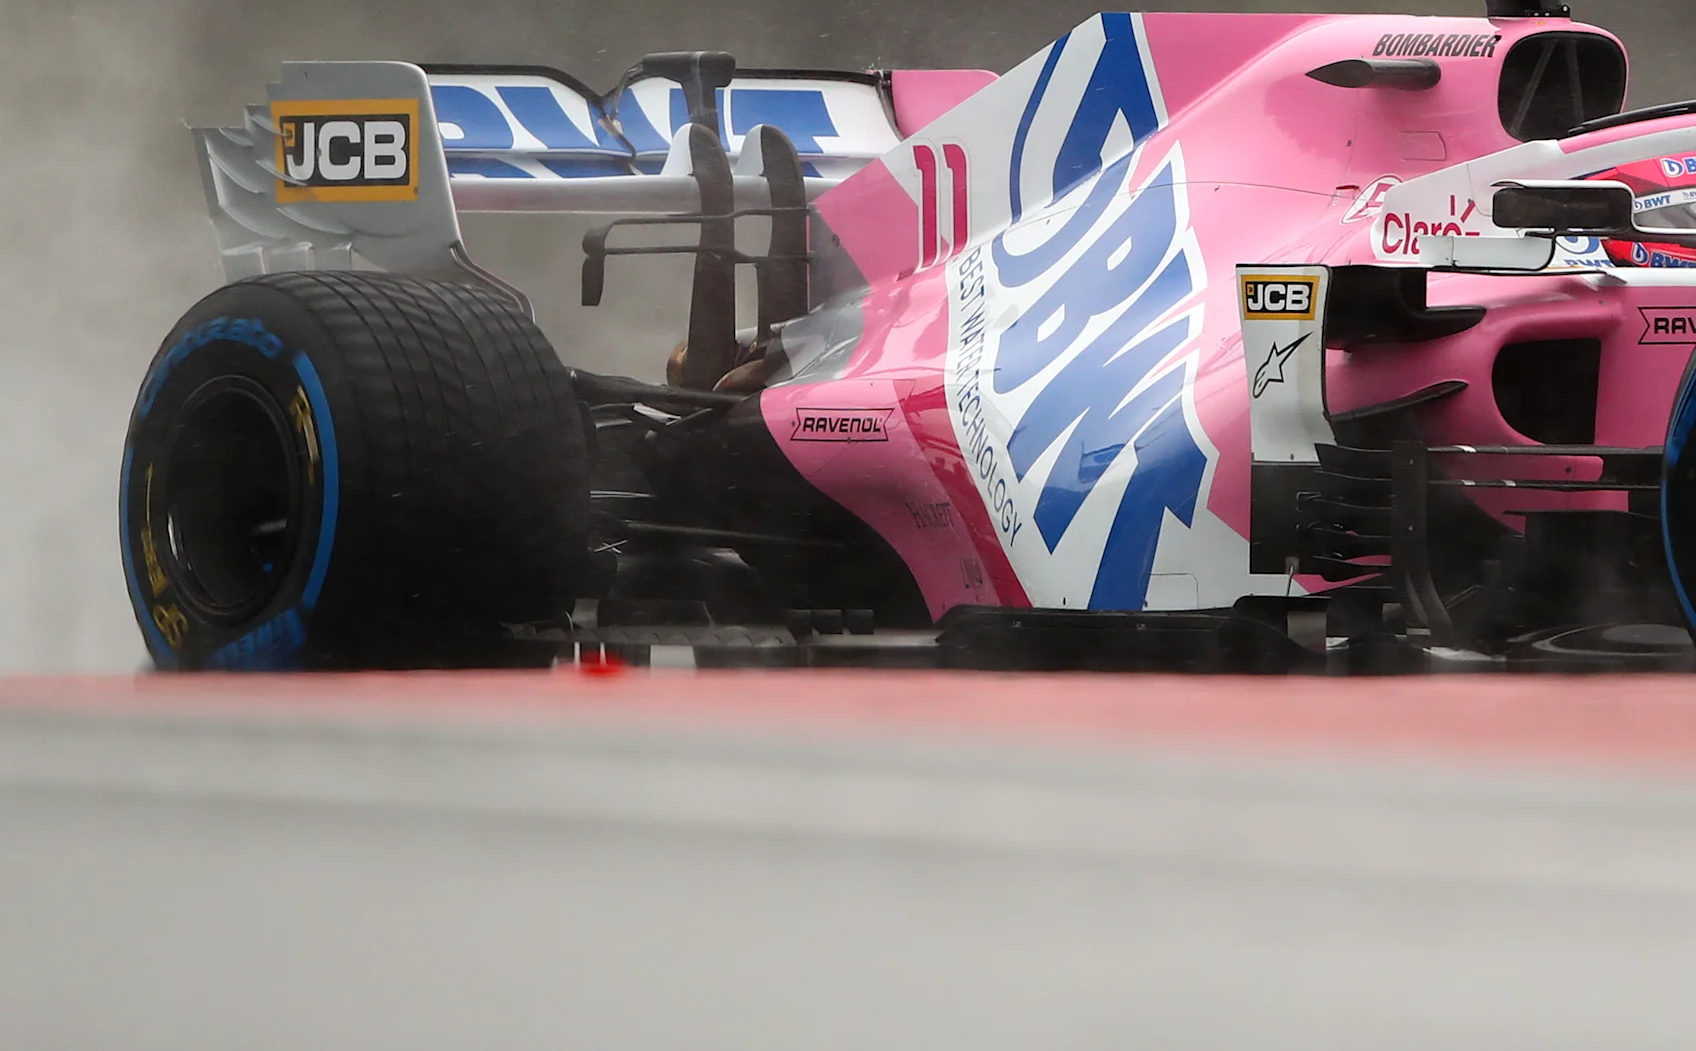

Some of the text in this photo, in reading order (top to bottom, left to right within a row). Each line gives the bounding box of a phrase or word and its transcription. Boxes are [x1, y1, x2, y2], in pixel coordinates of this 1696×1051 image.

[1372, 34, 1502, 58] BOMBARDIER
[286, 121, 407, 181] JCB
[913, 141, 971, 269] 11
[1643, 195, 1671, 209] BWT
[958, 247, 985, 312] BEST
[1247, 283, 1310, 311] JCB
[956, 305, 986, 382] WATER
[994, 157, 1208, 611] BWT
[802, 417, 881, 433] RAVENOL
[957, 368, 1022, 547] TECHNOLOGY
